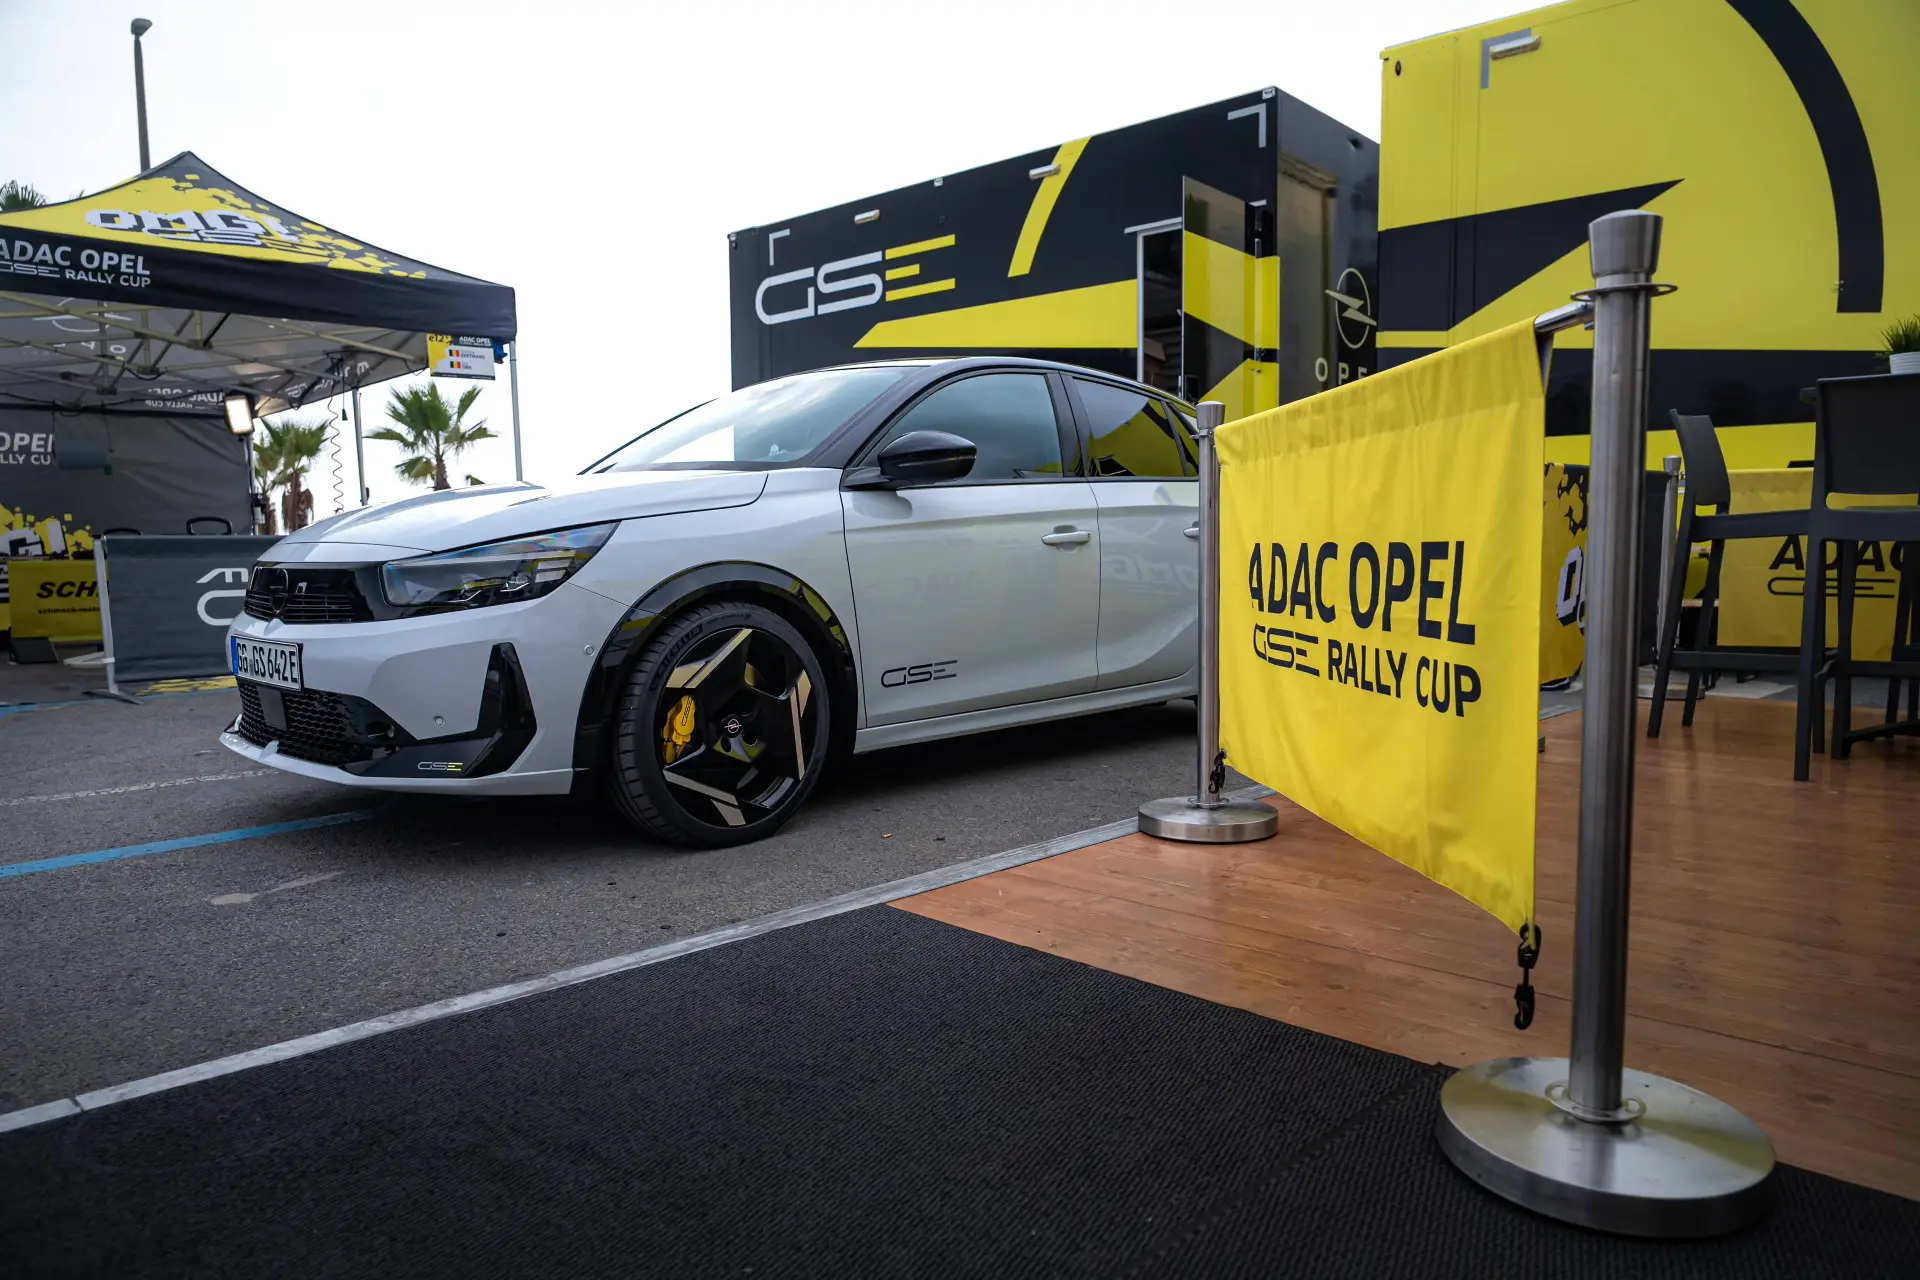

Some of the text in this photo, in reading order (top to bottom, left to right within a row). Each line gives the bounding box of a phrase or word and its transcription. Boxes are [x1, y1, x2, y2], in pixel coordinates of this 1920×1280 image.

[0, 238, 150, 275] ADAC OPEL
[65, 268, 116, 284] RALLY
[120, 275, 151, 288] CUP
[755, 234, 956, 325] GSE
[1315, 357, 1368, 386] OPE
[30, 454, 51, 465] CU
[36, 580, 100, 599] SCH
[1249, 541, 1338, 623] ADAC
[1349, 541, 1476, 645] OPEL
[881, 660, 957, 688] GSE
[1253, 623, 1481, 717] GSE RALLY CUP
[417, 761, 463, 771] GSE
